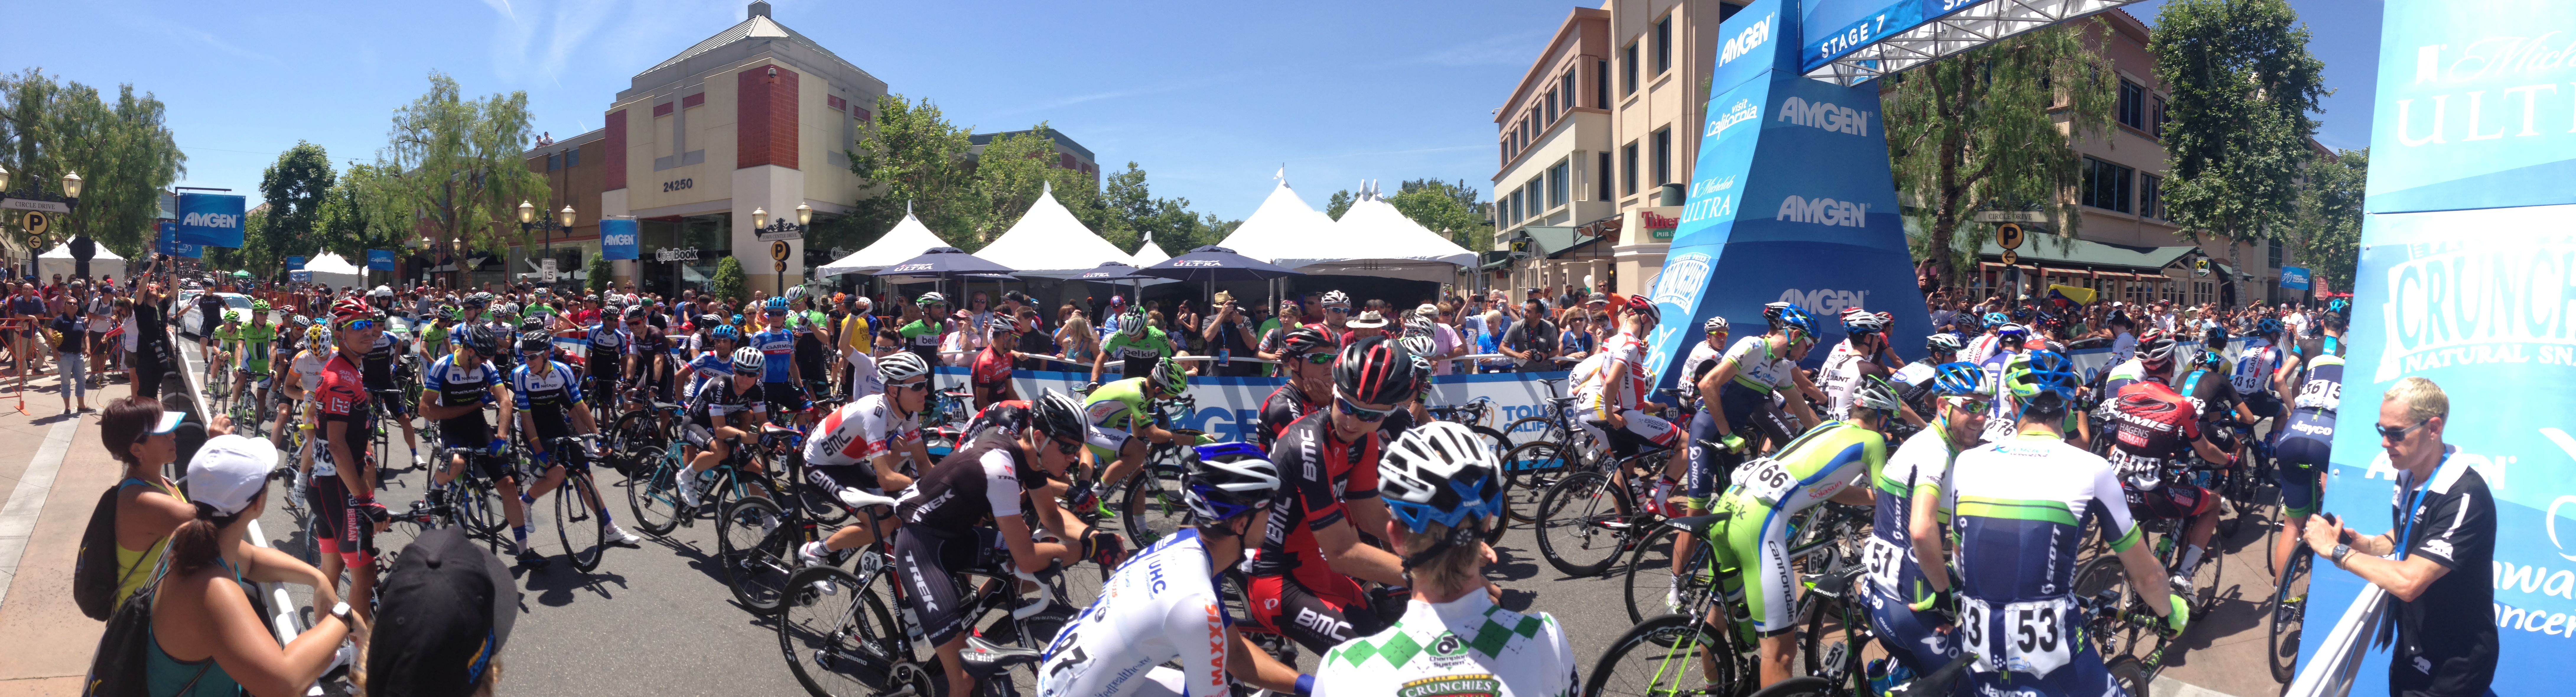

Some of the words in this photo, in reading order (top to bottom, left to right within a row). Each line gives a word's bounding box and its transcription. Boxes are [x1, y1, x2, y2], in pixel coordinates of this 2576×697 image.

[1719, 15, 1770, 67] AMGEN
[1821, 24, 1868, 58] STAGE
[1876, 15, 1885, 34] 7
[1732, 98, 1747, 113] visit
[1706, 103, 1757, 139] California
[1778, 96, 1867, 137] AMGEN
[663, 179, 692, 192] 24250
[1697, 174, 1736, 197] Michelob
[1682, 193, 1731, 223] ULTRA
[1777, 195, 1865, 228] AMGEN
[30, 214, 43, 231] P
[183, 212, 237, 228] AMGEN
[604, 235, 634, 245] AMGEN
[2003, 227, 2017, 245] P
[775, 244, 783, 257] P
[1778, 288, 1864, 315] AMGEN
[1154, 332, 1169, 350] belkin
[1124, 348, 1156, 358] belkin
[1967, 341, 1979, 362] ARMIN
[2248, 346, 2263, 373] GARMIN
[2257, 352, 2266, 369] SHARP
[2405, 344, 2530, 373] NATURAL
[2234, 376, 2243, 386] 13
[2245, 378, 2256, 389] 13
[1904, 386, 1922, 398] OMEGA
[1908, 389, 1925, 401] PHARMA
[1093, 405, 1112, 419] Sojasun
[1546, 406, 1556, 414] 116
[1768, 412, 1795, 440] TREK
[2000, 422, 2014, 436] 76
[2117, 411, 2174, 432] JAMIS
[2120, 423, 2149, 438] HAGENS
[2292, 420, 2332, 435] Jayco
[821, 427, 852, 457] BMC
[1553, 430, 1564, 440] 118
[2118, 430, 2148, 447] BERMAN
[2217, 429, 2228, 441] sky
[1300, 429, 1317, 482] BMC
[1604, 461, 1616, 471] 158
[807, 469, 847, 502] BMC
[1759, 464, 1789, 489] 66
[1074, 489, 1088, 503] BMC
[1809, 481, 1842, 501] Sojasun
[2174, 493, 2193, 506] BERMAN
[2175, 487, 2194, 498] HAGENS
[912, 489, 955, 523] TREK
[347, 508, 357, 541] BERMAN
[1266, 497, 1292, 545] BMC
[1811, 555, 1823, 569] 66
[1871, 544, 1892, 576] 51
[2047, 524, 2061, 582] SCOTT
[862, 557, 877, 574] 34
[905, 550, 939, 613] TREK
[1148, 562, 1166, 595] UHC
[1768, 540, 1794, 623] cannondale
[888, 585, 900, 617] SHIMANO
[1814, 588, 1840, 598] prologo
[930, 625, 950, 639] TREK
[1295, 607, 1353, 641] BMC
[1878, 617, 1895, 636] CRAFT
[2017, 607, 2058, 654] 53
[1205, 604, 1224, 686] MAXXIS
[839, 651, 867, 666] SHIMANO
[1429, 654, 1468, 663] Champion
[1824, 650, 1841, 667] 51
[1404, 681, 1493, 697] CRUNCHIES
